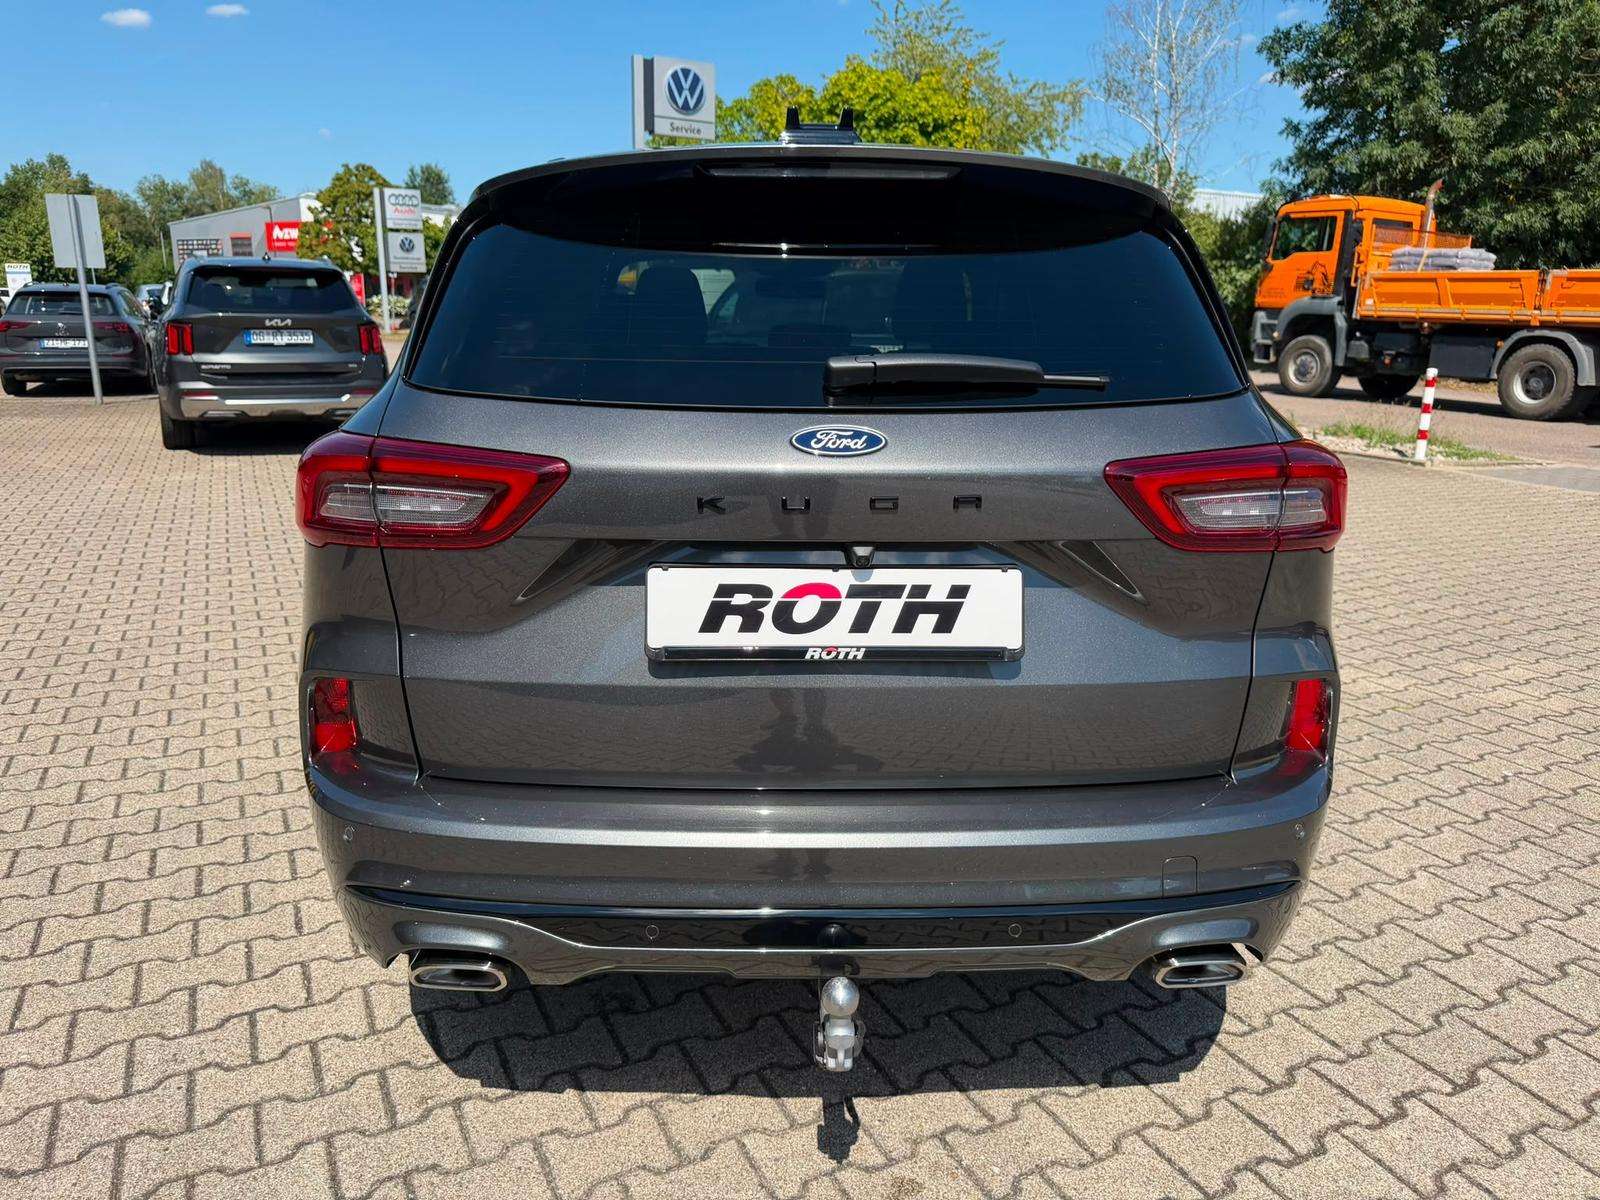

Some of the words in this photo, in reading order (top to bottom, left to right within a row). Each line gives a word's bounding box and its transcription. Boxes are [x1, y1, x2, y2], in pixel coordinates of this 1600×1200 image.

[670, 122, 702, 135] Service
[810, 430, 868, 449] Ford
[696, 495, 983, 515] KUGA
[697, 582, 972, 635] ROTH
[803, 646, 867, 660] ROTH
